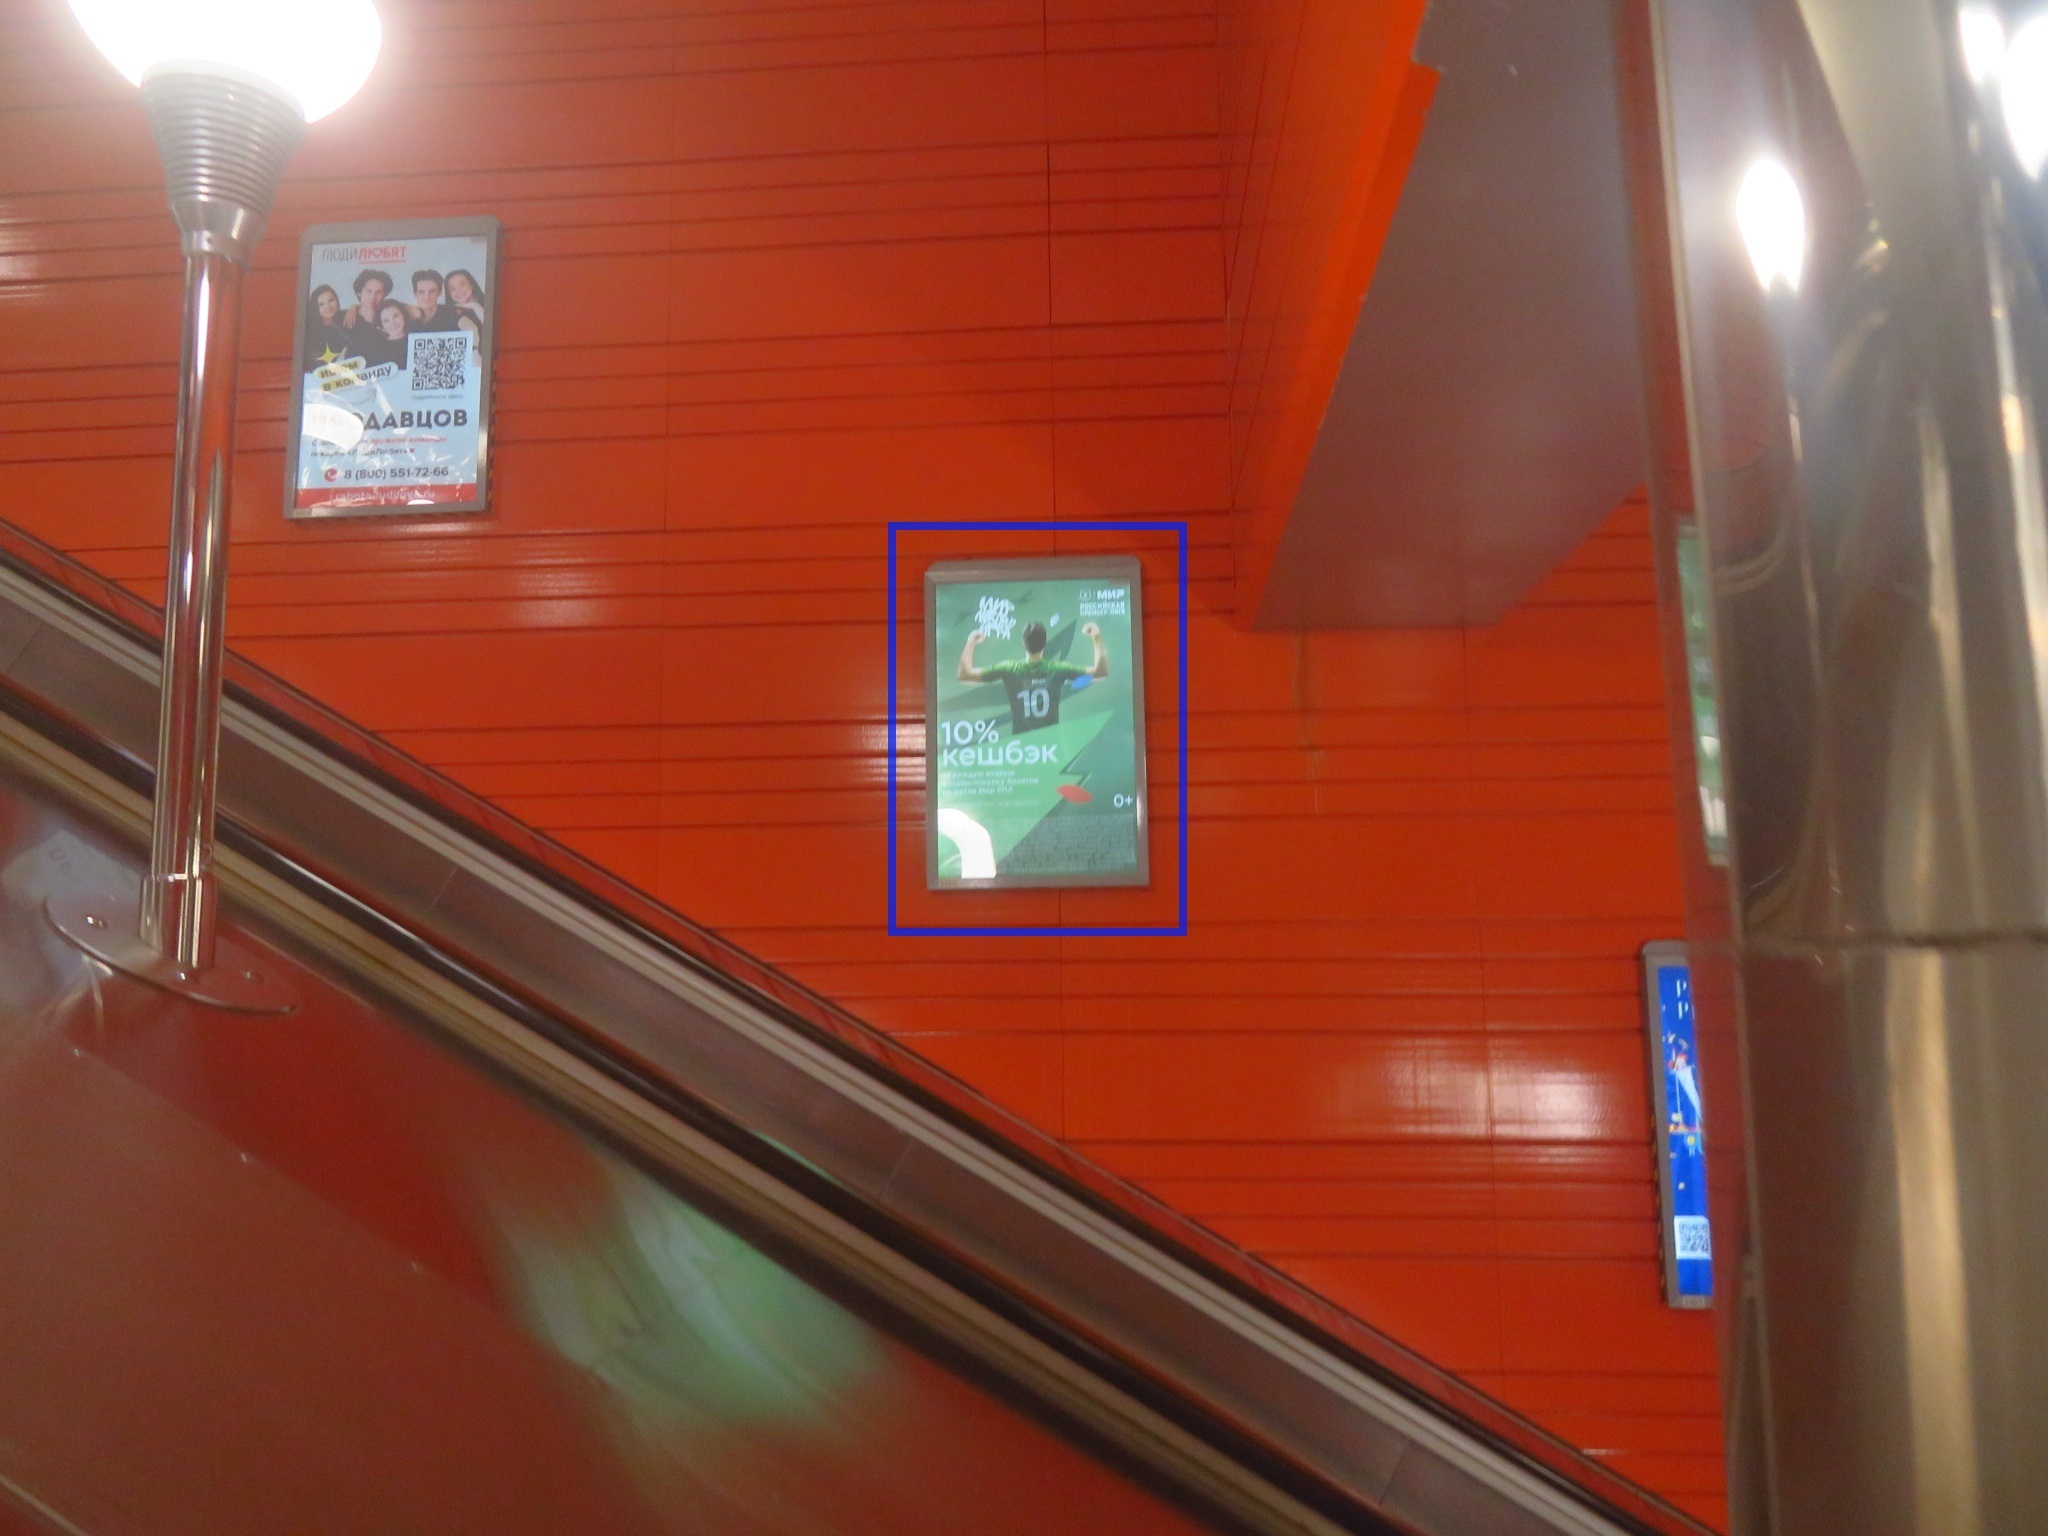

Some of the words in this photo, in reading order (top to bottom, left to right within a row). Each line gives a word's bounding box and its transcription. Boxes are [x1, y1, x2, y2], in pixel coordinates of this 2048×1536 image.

[335, 365, 392, 387] коанду
[344, 469, 352, 479] 8
[355, 468, 387, 480] (800)
[390, 466, 449, 478] 551-72-66
[1097, 588, 1124, 600] МИР
[1017, 689, 1050, 718] 10
[941, 719, 999, 746] 10%
[942, 739, 1059, 768] кешбэк
[1113, 793, 1134, 808] 0+
